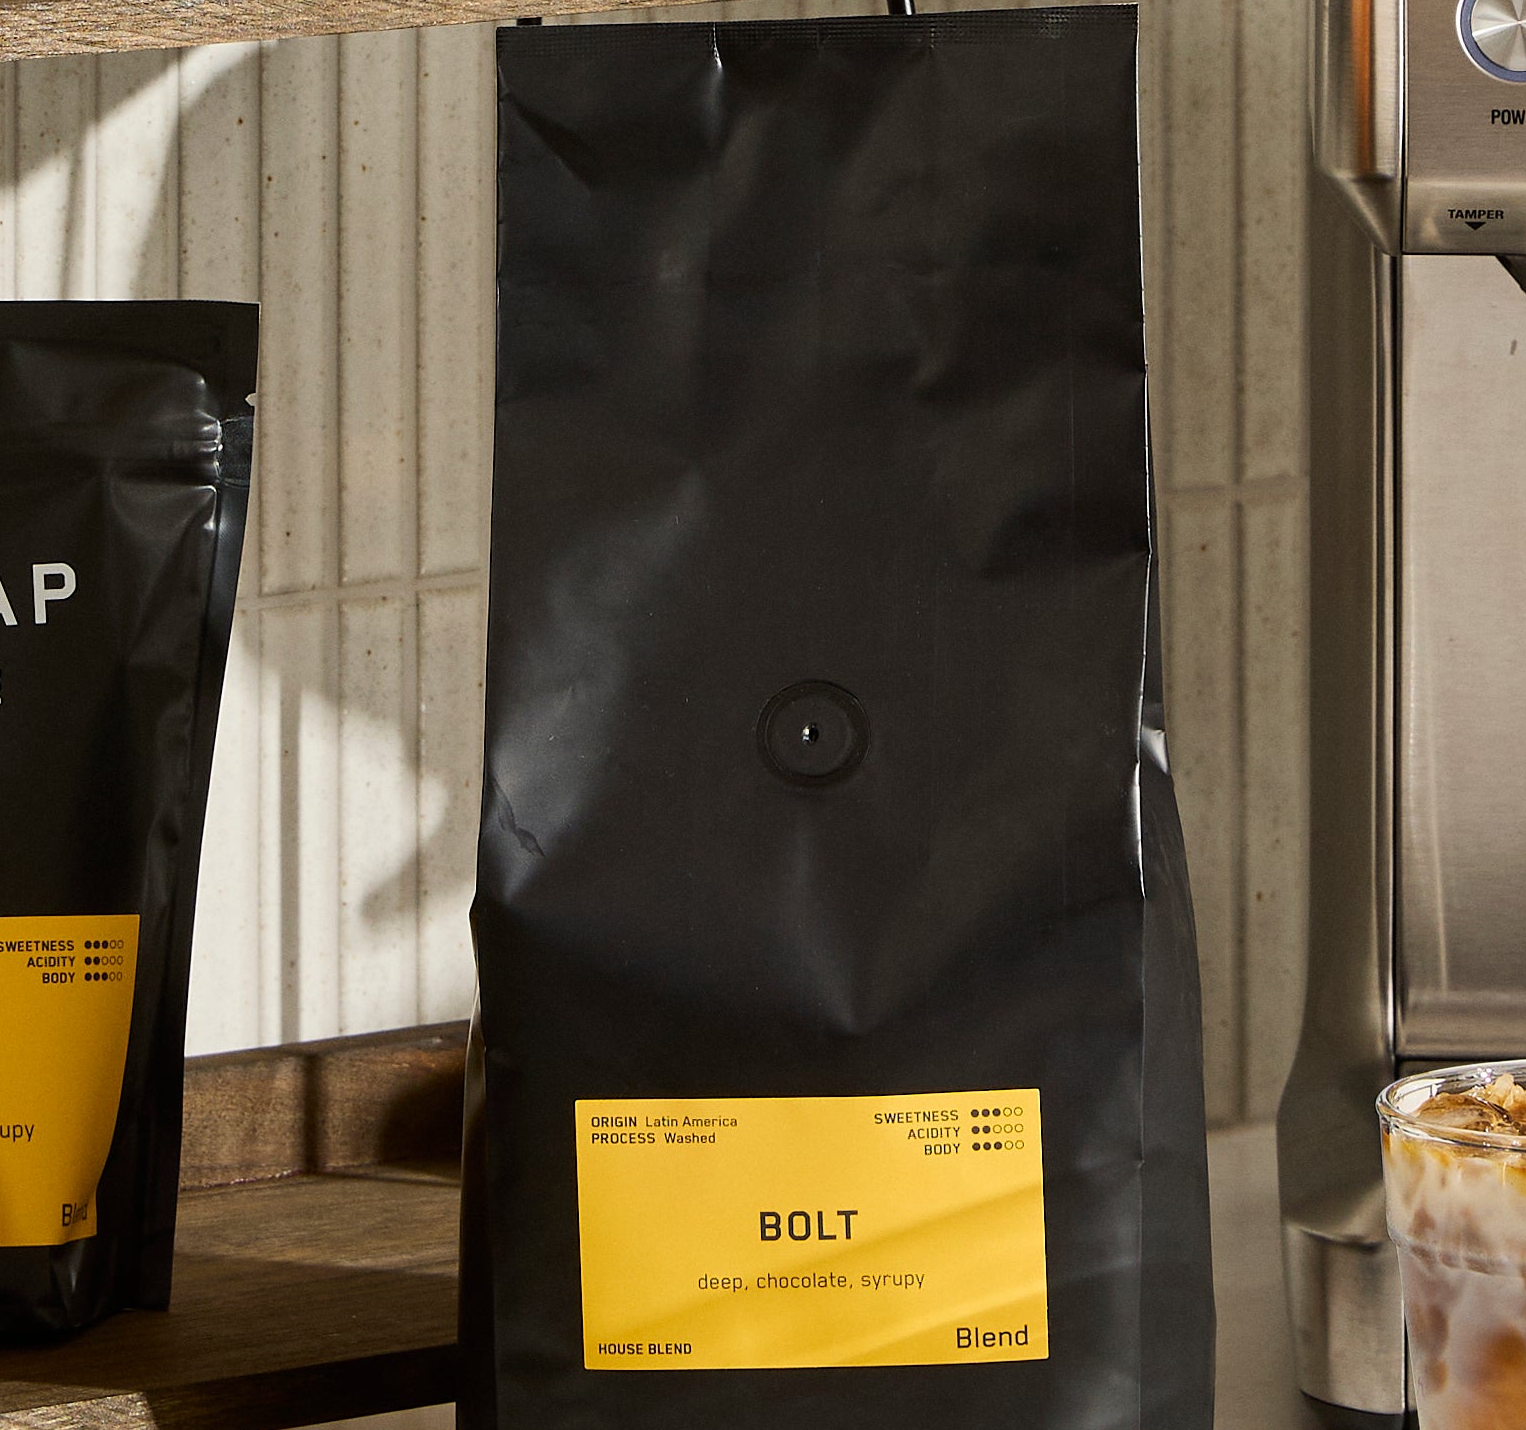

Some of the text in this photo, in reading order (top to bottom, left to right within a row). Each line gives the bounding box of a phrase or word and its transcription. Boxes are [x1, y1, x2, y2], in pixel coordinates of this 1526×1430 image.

[1448, 209, 1504, 219] TAMPER
[27, 956, 75, 967] ACIDITY
[42, 972, 75, 983] BODY
[592, 1116, 737, 1127] ORIGIN Latin America
[875, 1110, 958, 1124] SWEETNESS
[592, 1133, 715, 1144] PROCESS Washed
[908, 1127, 960, 1139] ACIDITY
[925, 1144, 960, 1155] BODY
[760, 1210, 858, 1241] BOLT
[699, 1272, 924, 1292] deep, chocolate, syrupy
[957, 1325, 1028, 1348] Blend
[599, 1343, 691, 1354] HOUSE BLEND
